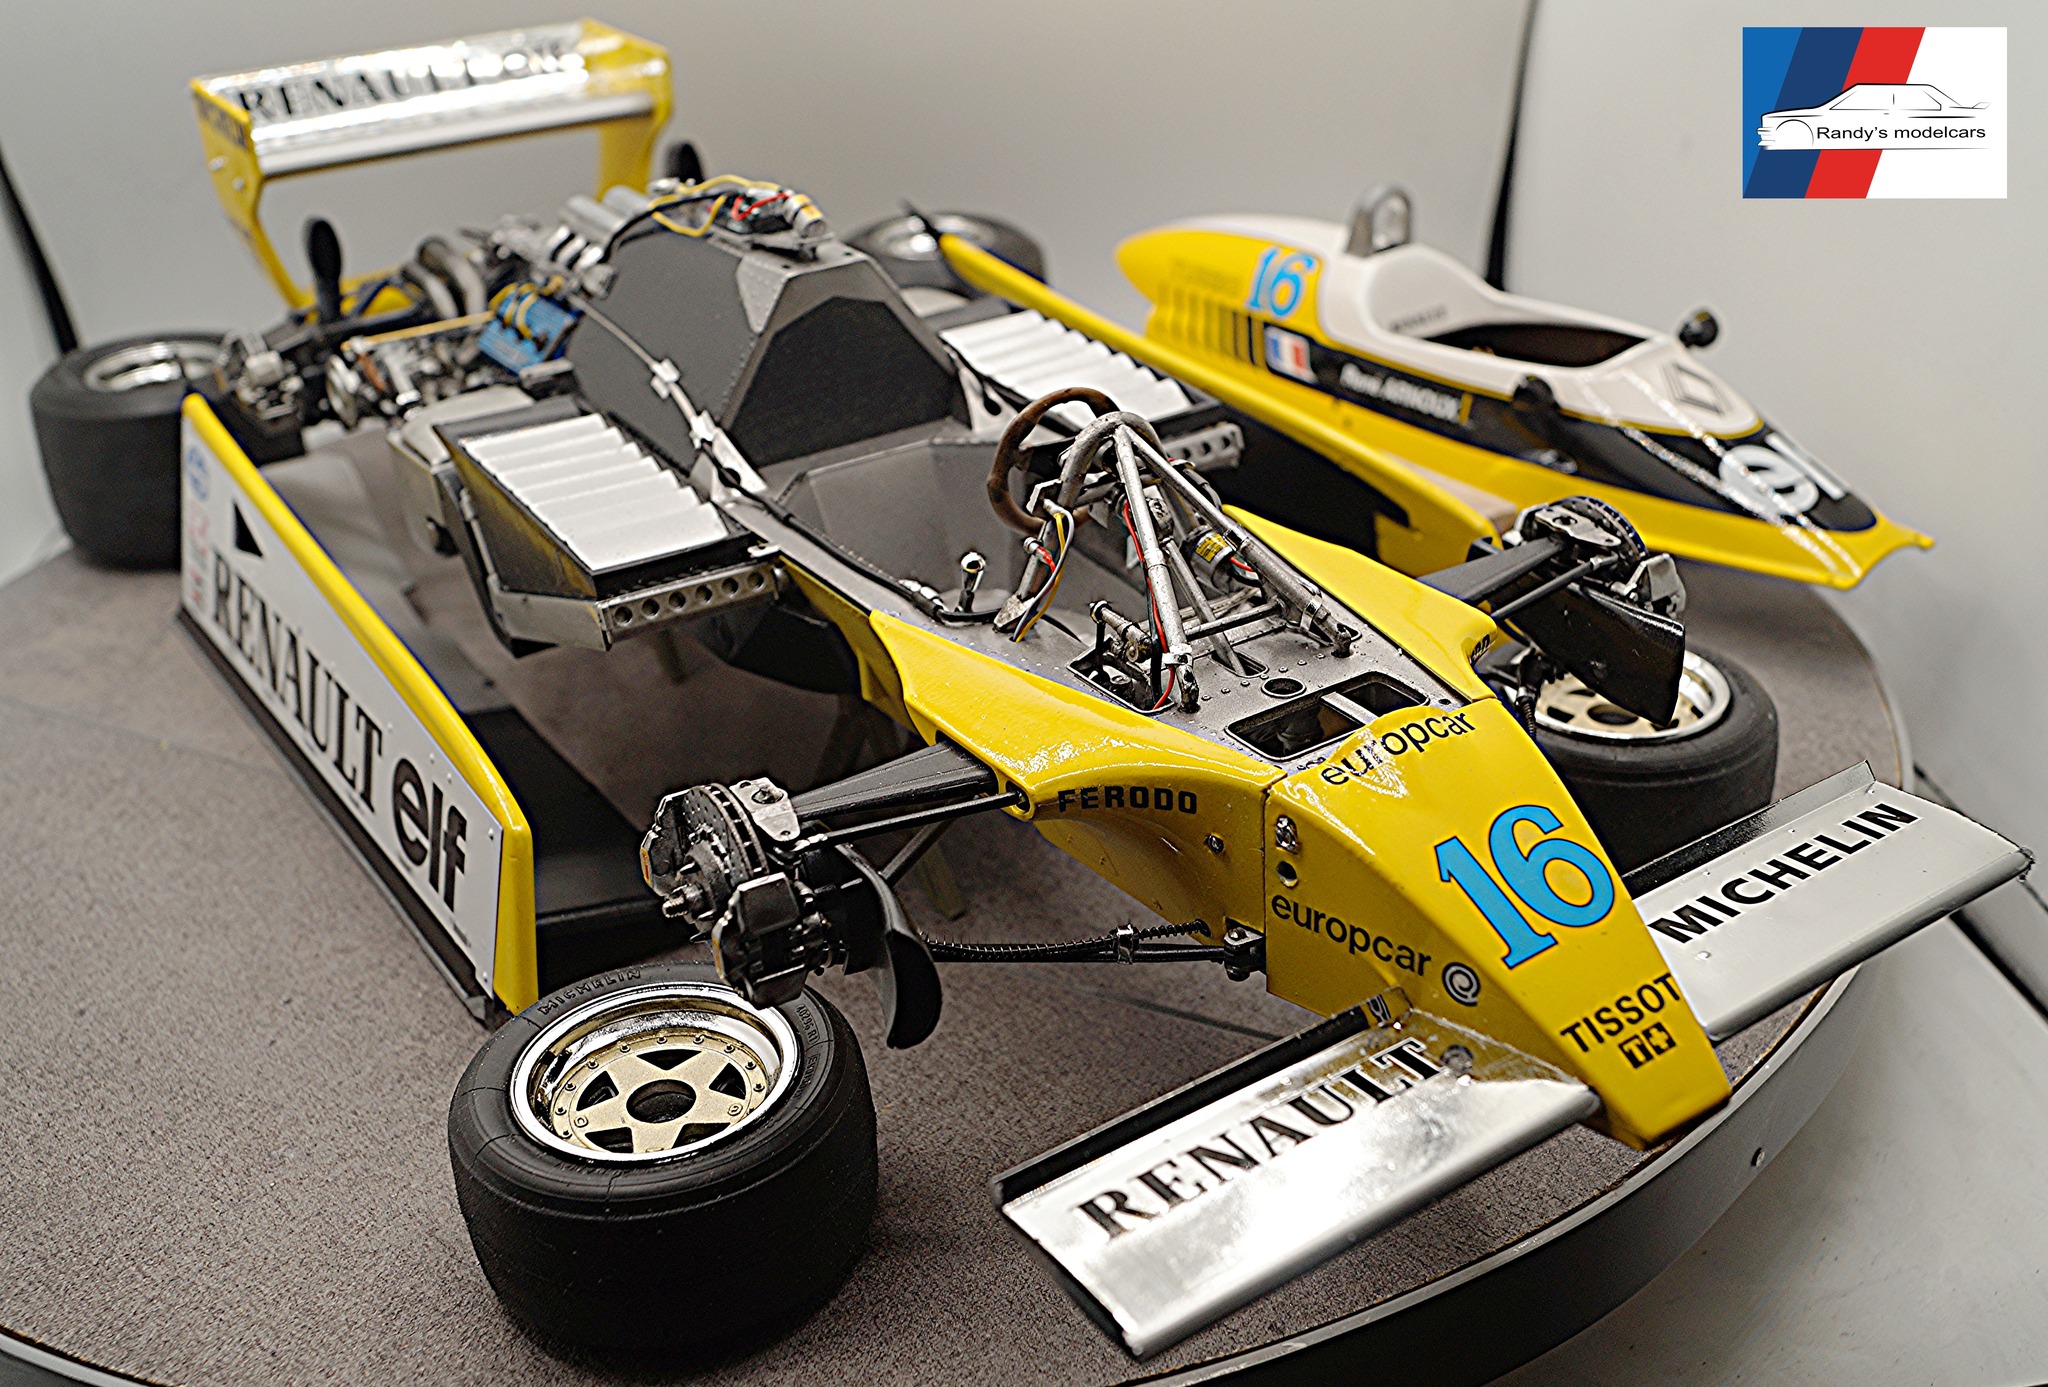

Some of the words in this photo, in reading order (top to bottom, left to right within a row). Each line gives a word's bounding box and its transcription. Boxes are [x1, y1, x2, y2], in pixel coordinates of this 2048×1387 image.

[1248, 248, 1315, 316] 16
[213, 551, 383, 814] RENAULT
[391, 757, 467, 912] elf
[1321, 711, 1475, 785] europcar
[1058, 785, 1197, 814] FERODO
[1434, 805, 1615, 970] 16
[1647, 803, 1919, 944] MICHELIN
[1271, 894, 1432, 977] europcar
[538, 968, 641, 1015] MICHELIN
[1560, 972, 1680, 1052] TISSOT
[1075, 1037, 1446, 1238] RENAULT
